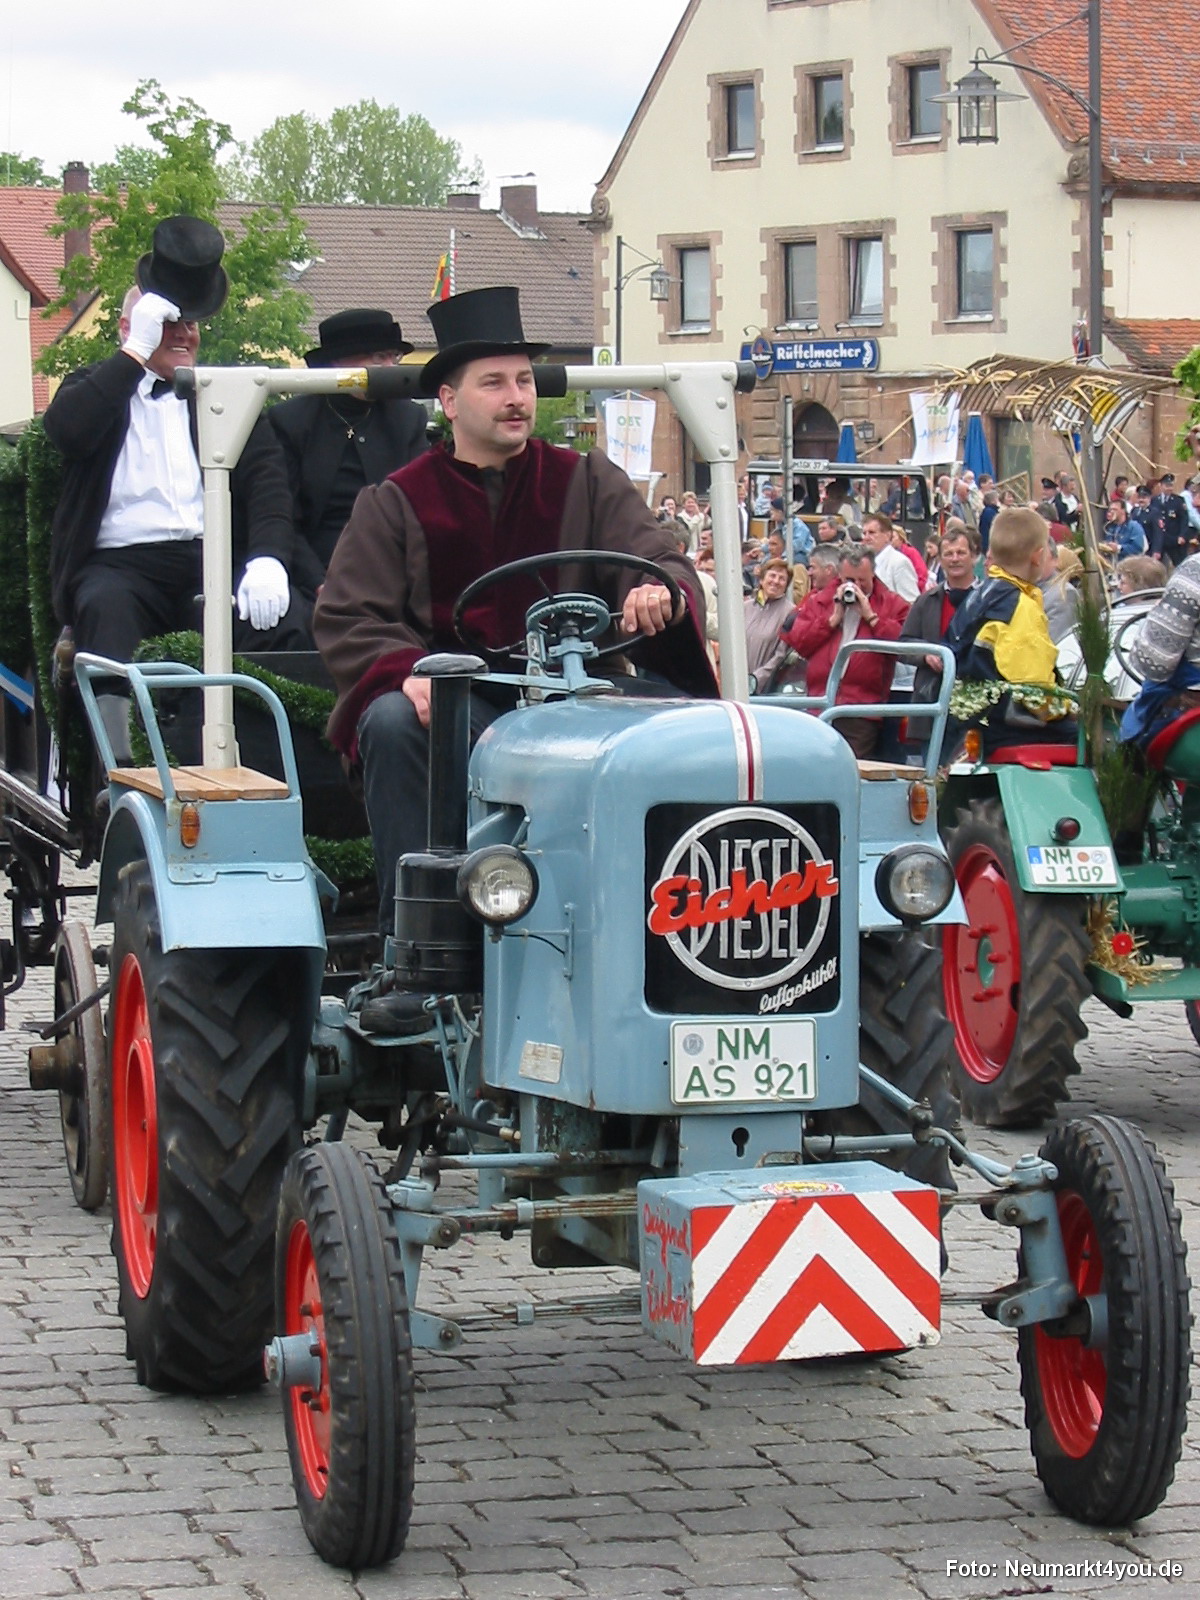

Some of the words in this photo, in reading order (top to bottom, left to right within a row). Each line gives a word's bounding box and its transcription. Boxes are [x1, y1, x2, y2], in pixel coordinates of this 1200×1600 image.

[777, 343, 861, 360] Rüffelmacher
[1044, 848, 1073, 864] NM
[1045, 866, 1058, 883] J
[1065, 866, 1104, 883] 109
[647, 860, 839, 936] Eicher
[690, 836, 805, 960] DIESEL
[716, 1027, 771, 1061] NM
[683, 1064, 737, 1098] AS
[754, 1063, 808, 1096] 921
